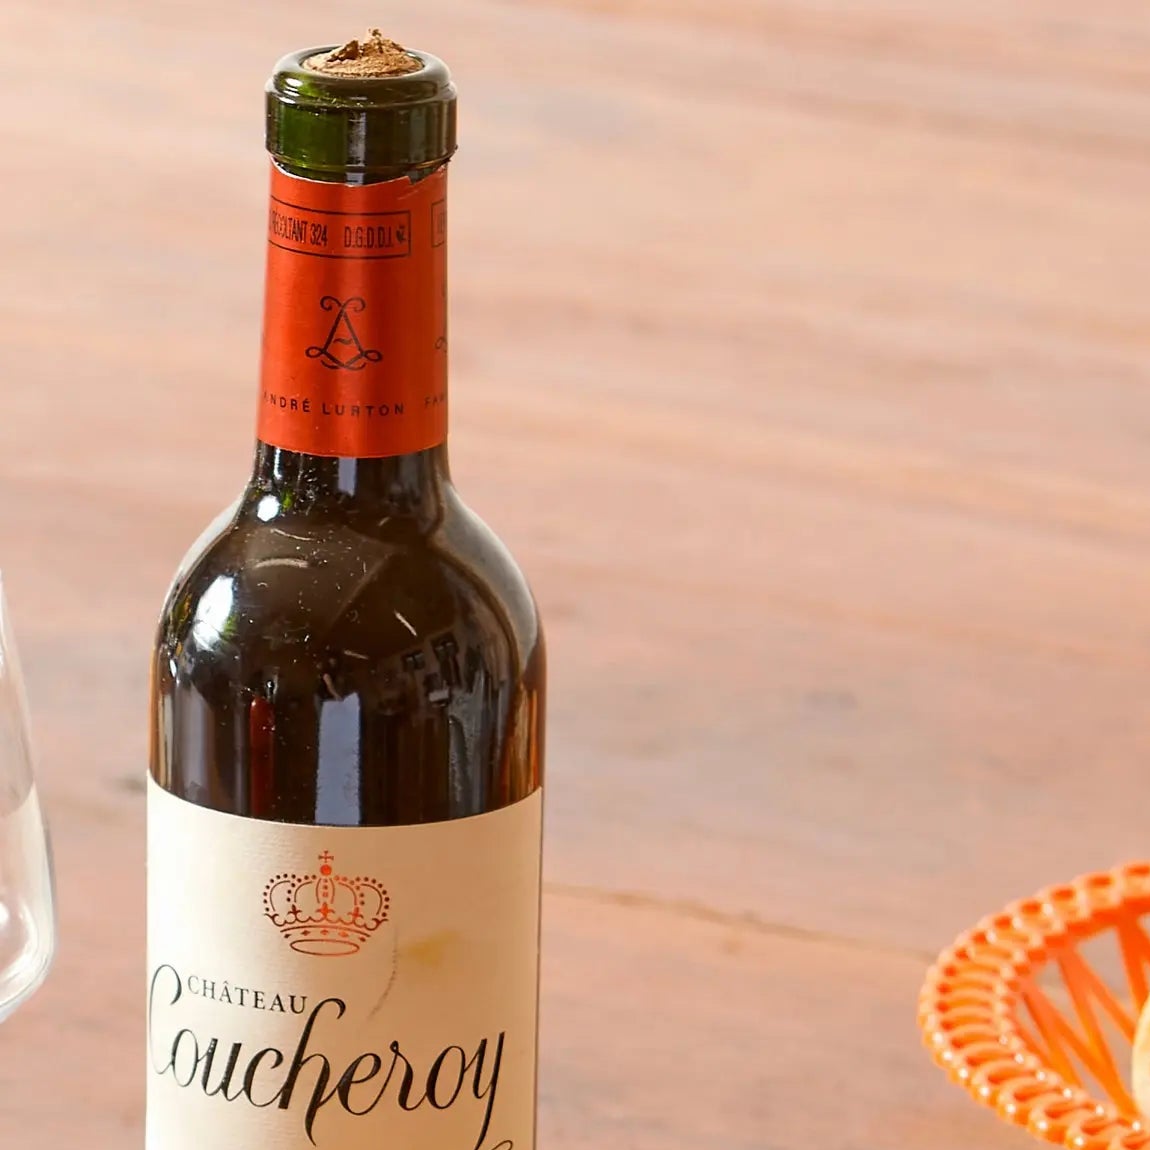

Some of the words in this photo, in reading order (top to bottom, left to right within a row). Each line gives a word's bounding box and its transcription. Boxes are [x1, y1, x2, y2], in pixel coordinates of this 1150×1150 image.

[309, 222, 328, 247] 324
[322, 403, 404, 417] LURTON
[187, 974, 309, 1016] CHÂTEAU
